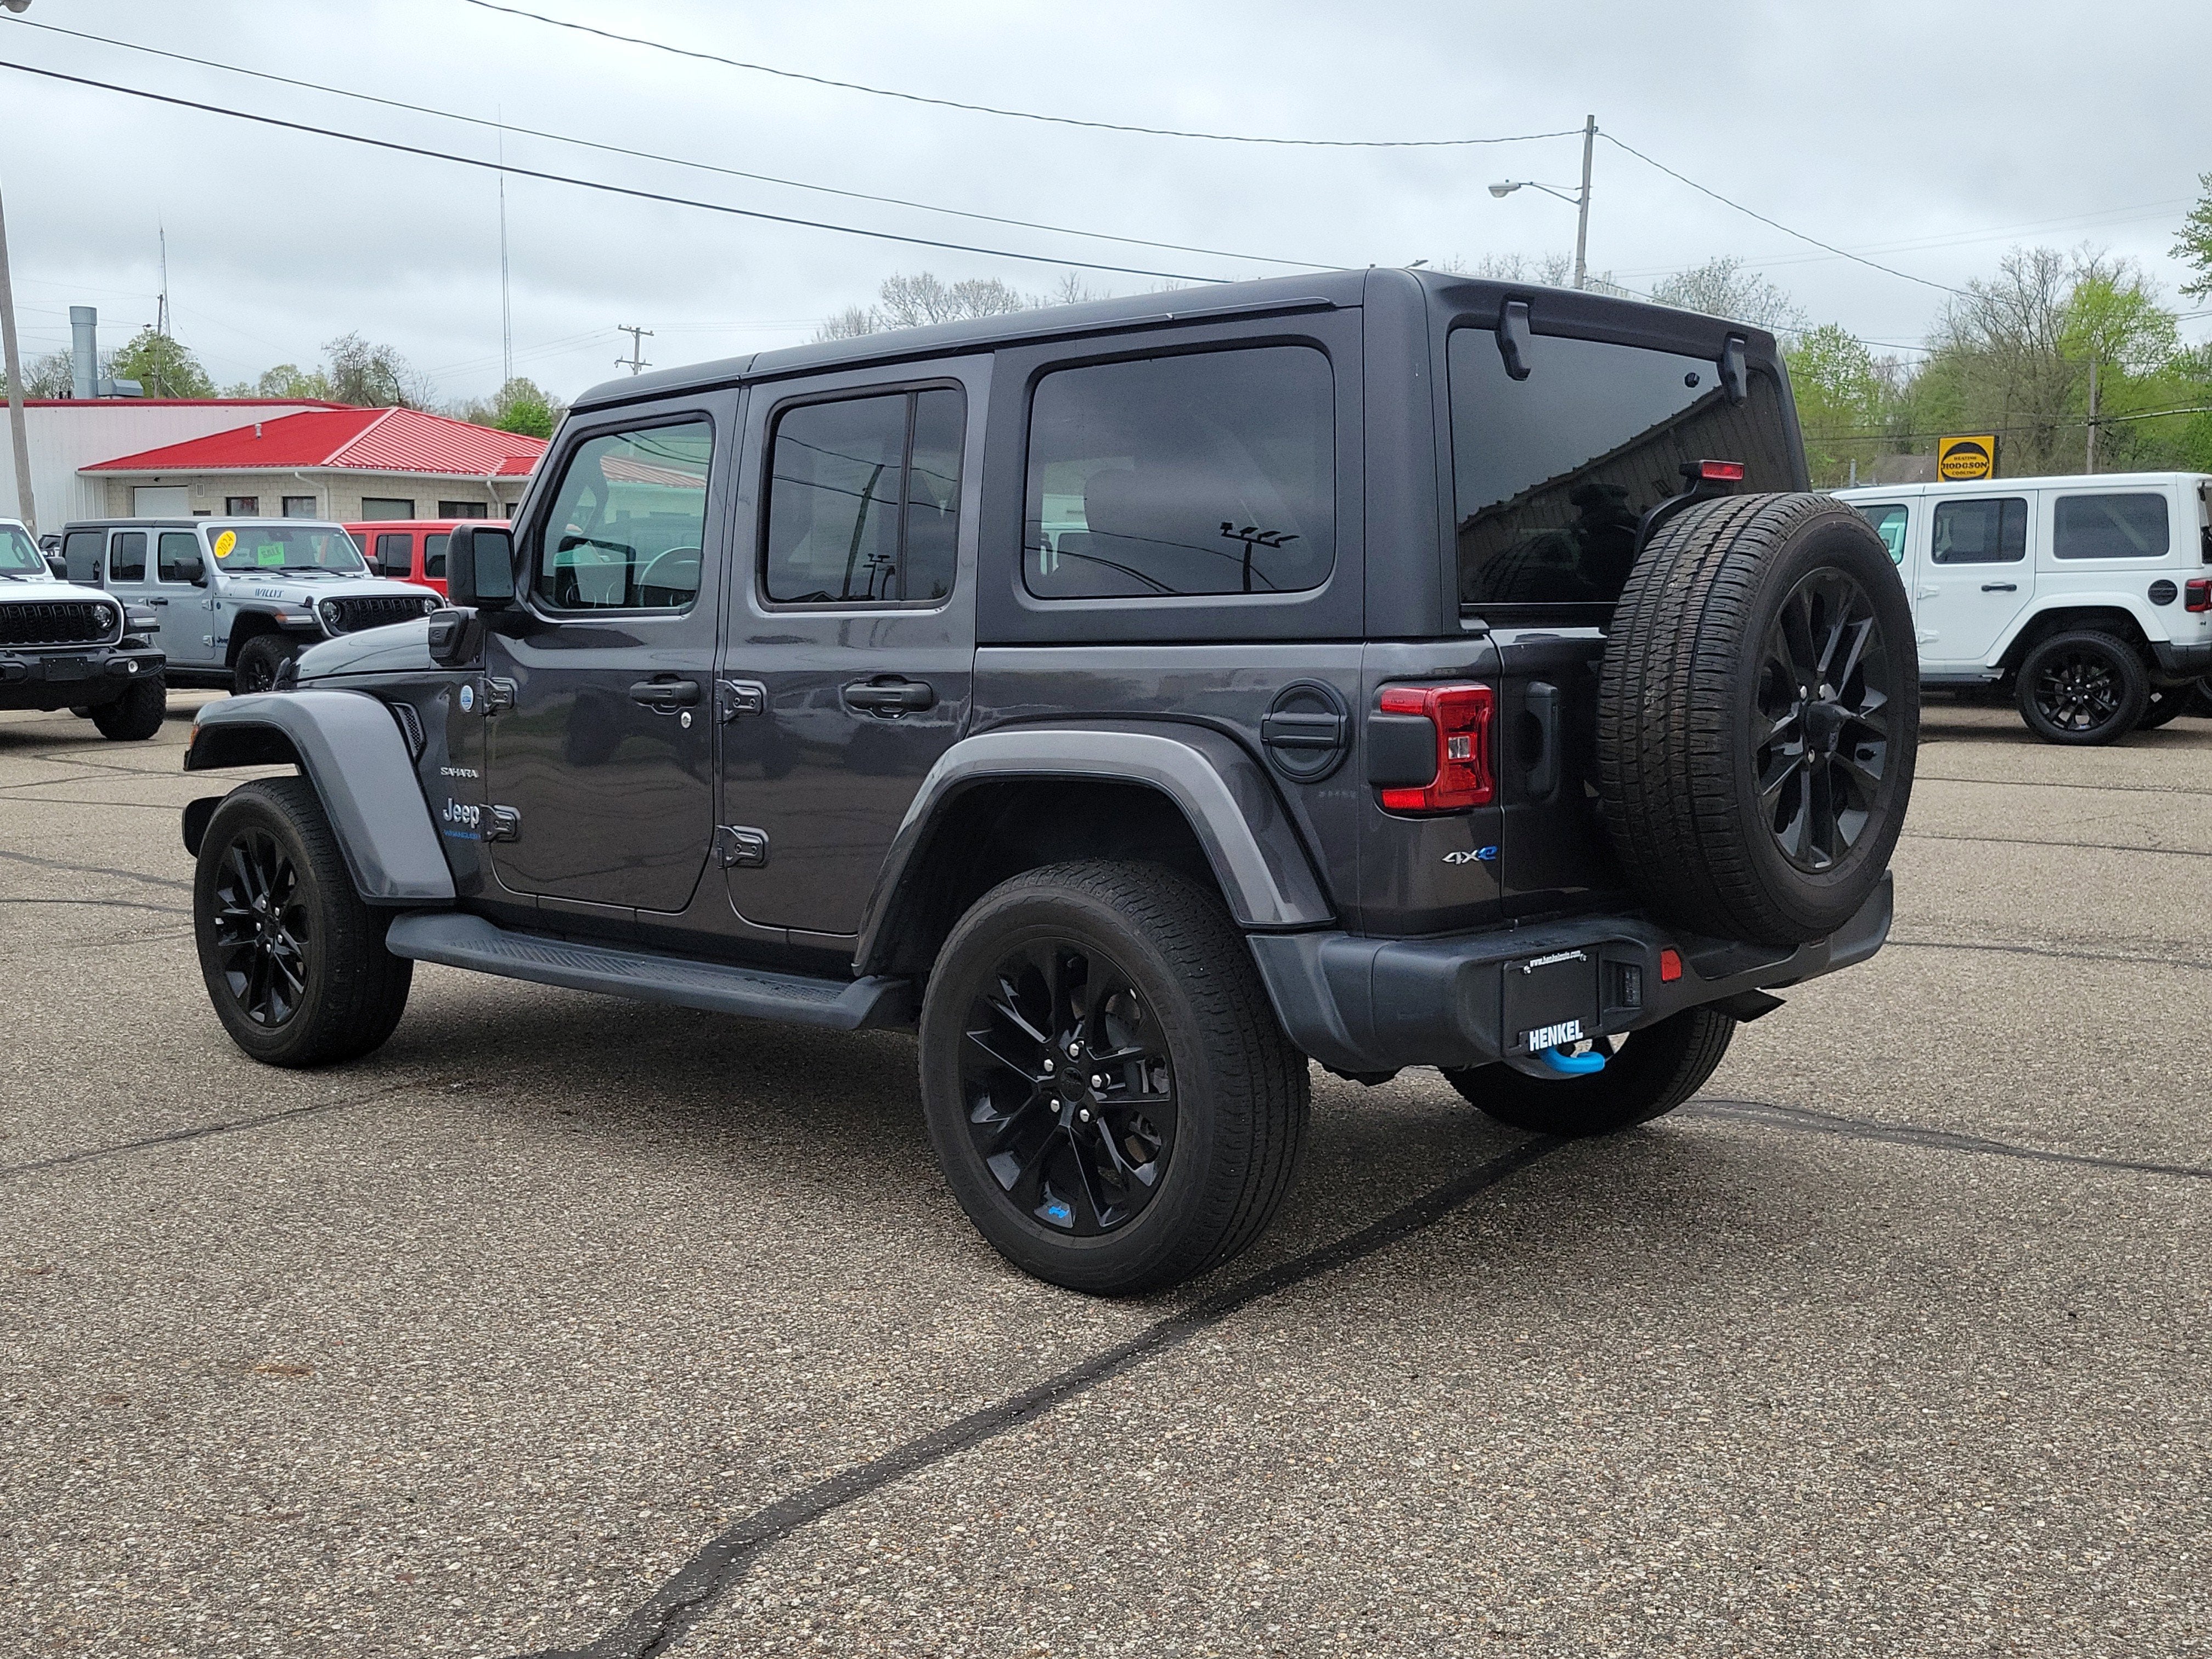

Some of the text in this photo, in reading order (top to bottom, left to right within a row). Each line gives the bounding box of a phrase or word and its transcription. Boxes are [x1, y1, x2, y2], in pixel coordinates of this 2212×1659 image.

[255, 588, 284, 598] WILLYS
[440, 767, 479, 778] SAHARA
[442, 798, 480, 829] Jeep
[1529, 1019, 1584, 1052] HENKEL
